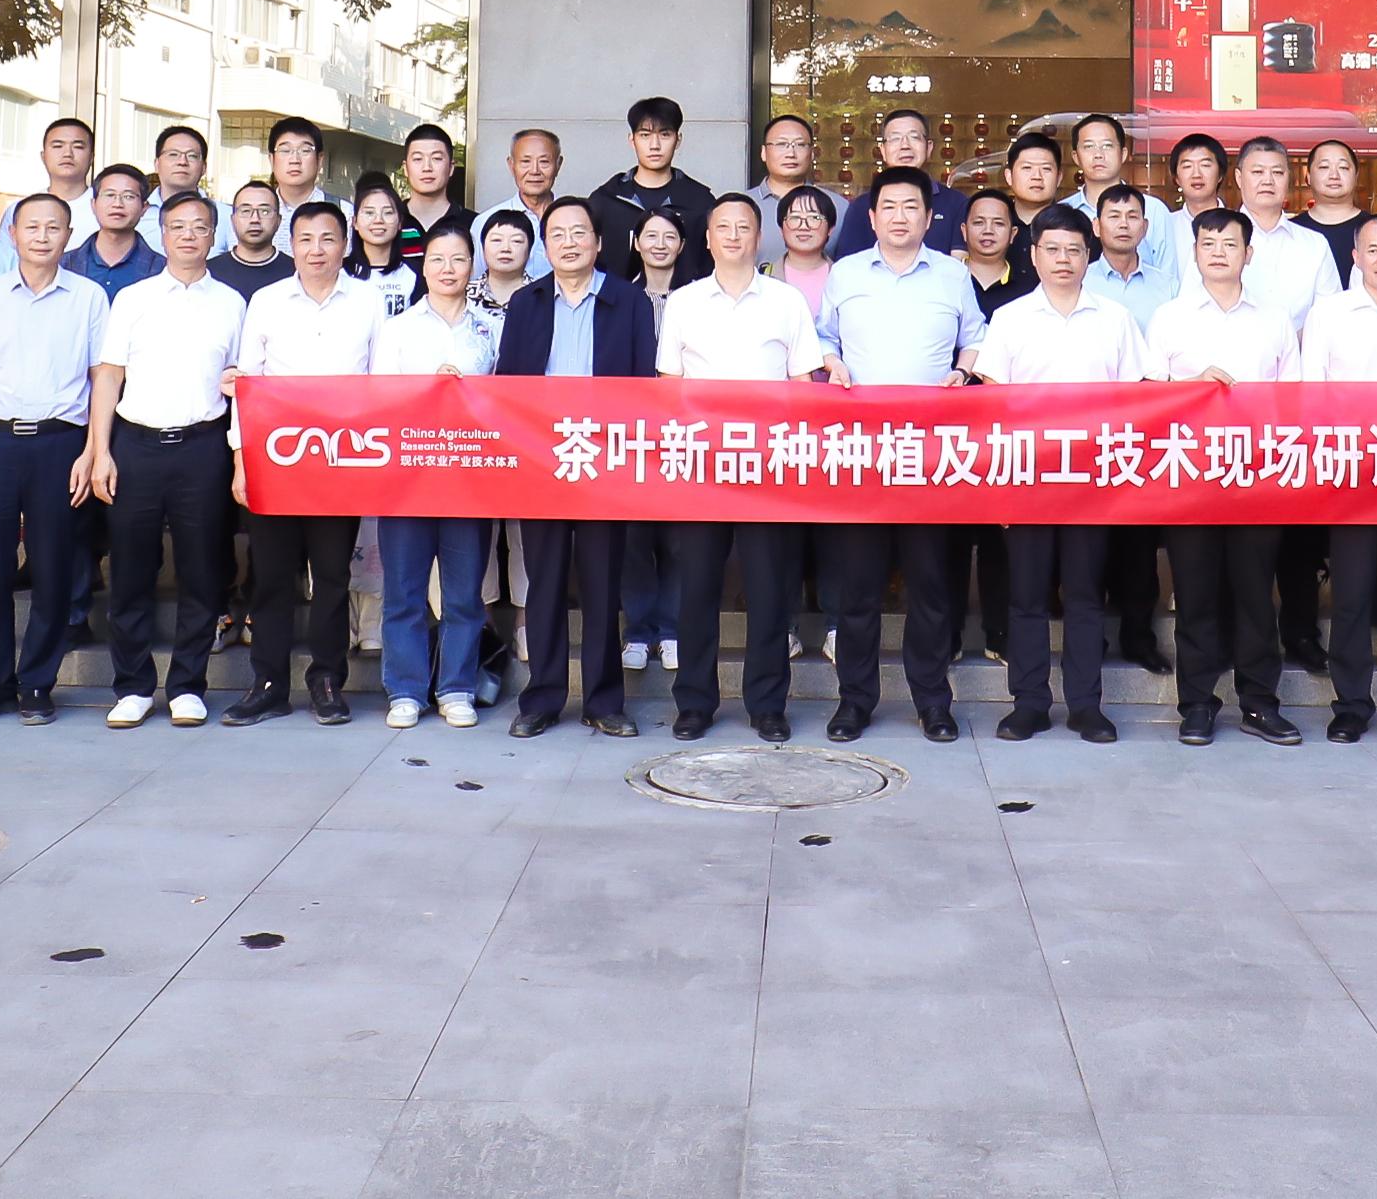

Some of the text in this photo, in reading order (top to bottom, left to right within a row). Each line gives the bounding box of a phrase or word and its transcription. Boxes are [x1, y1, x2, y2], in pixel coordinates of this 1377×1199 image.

[400, 427, 501, 441] China Agriculture
[400, 441, 482, 453] Research System
[400, 455, 518, 469] 现代农业产业技术体系
